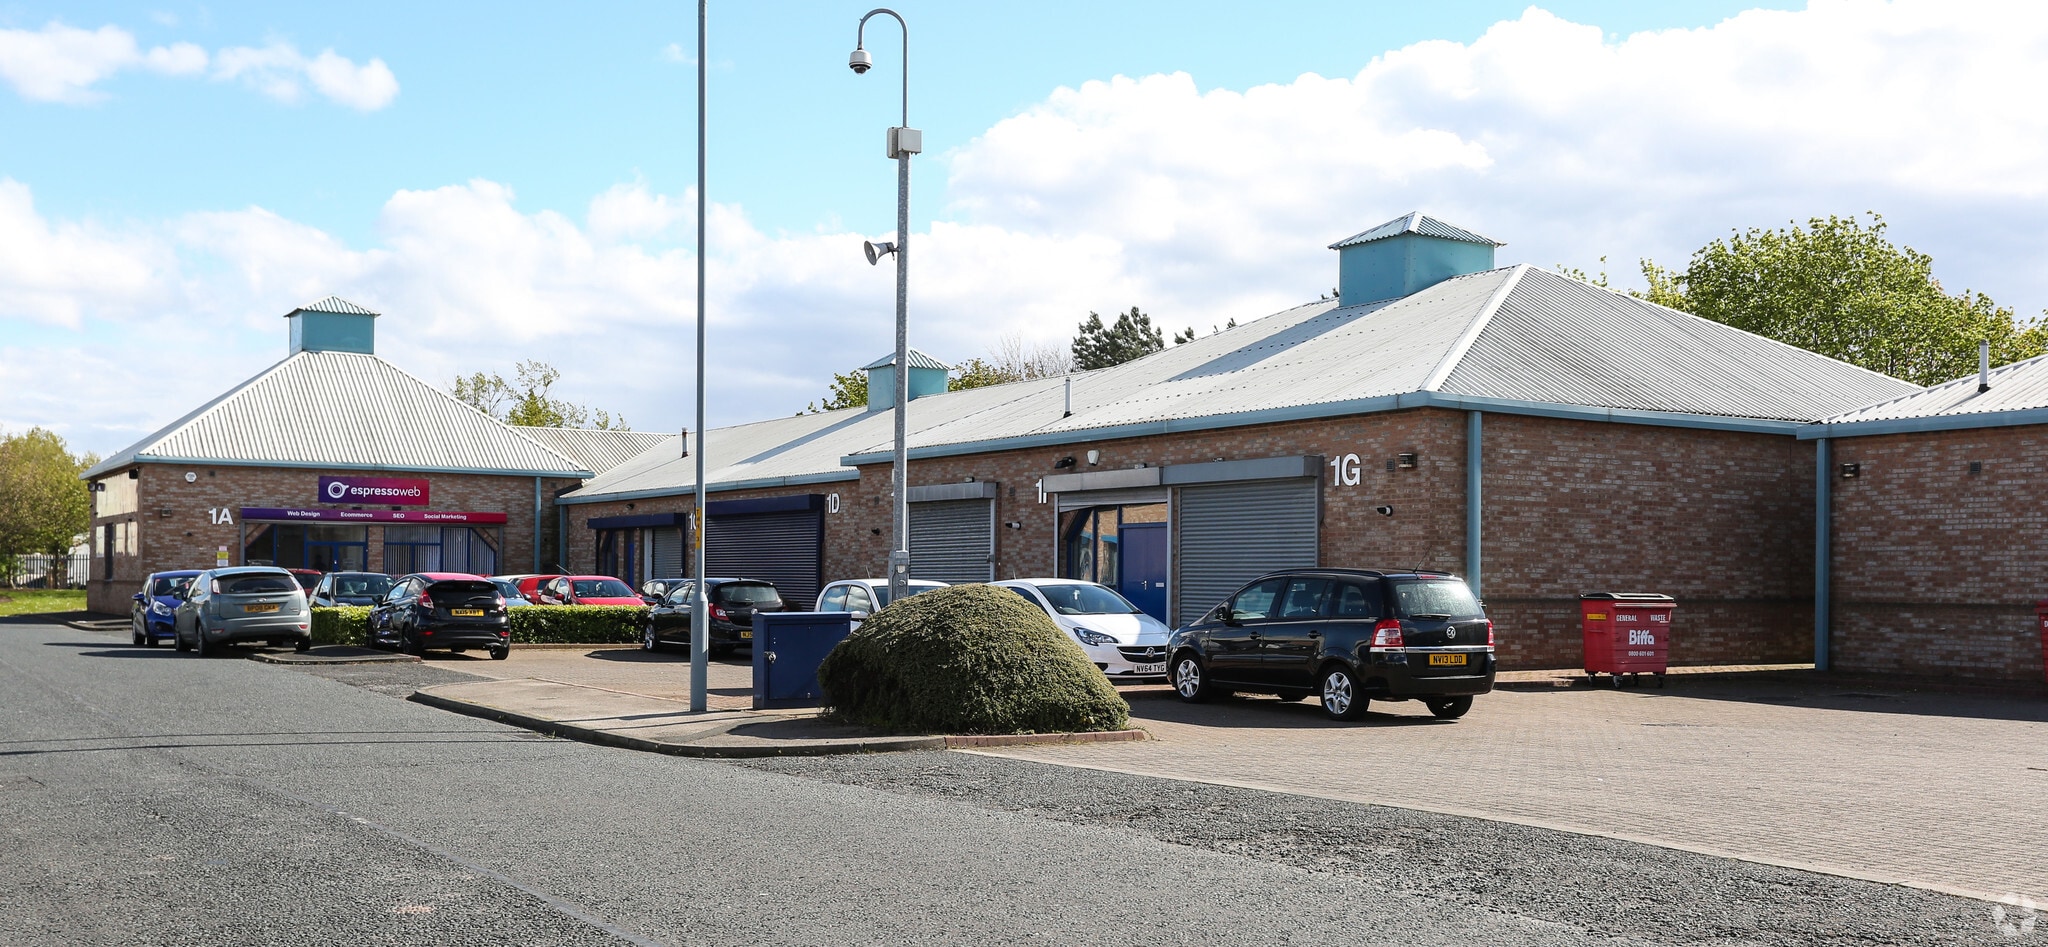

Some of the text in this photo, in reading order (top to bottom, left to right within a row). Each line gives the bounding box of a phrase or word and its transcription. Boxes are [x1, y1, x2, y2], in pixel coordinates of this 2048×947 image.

[1330, 453, 1361, 487] 1G
[350, 485, 421, 498] espressoweb
[826, 492, 840, 514] 1D
[208, 507, 234, 525] 1A
[300, 510, 321, 518] Design
[1616, 614, 1666, 622] GENERAL WASTE
[1628, 629, 1655, 645] Biffa
[1433, 655, 1448, 664] NV13
[1136, 664, 1165, 673] NV64 TYG
